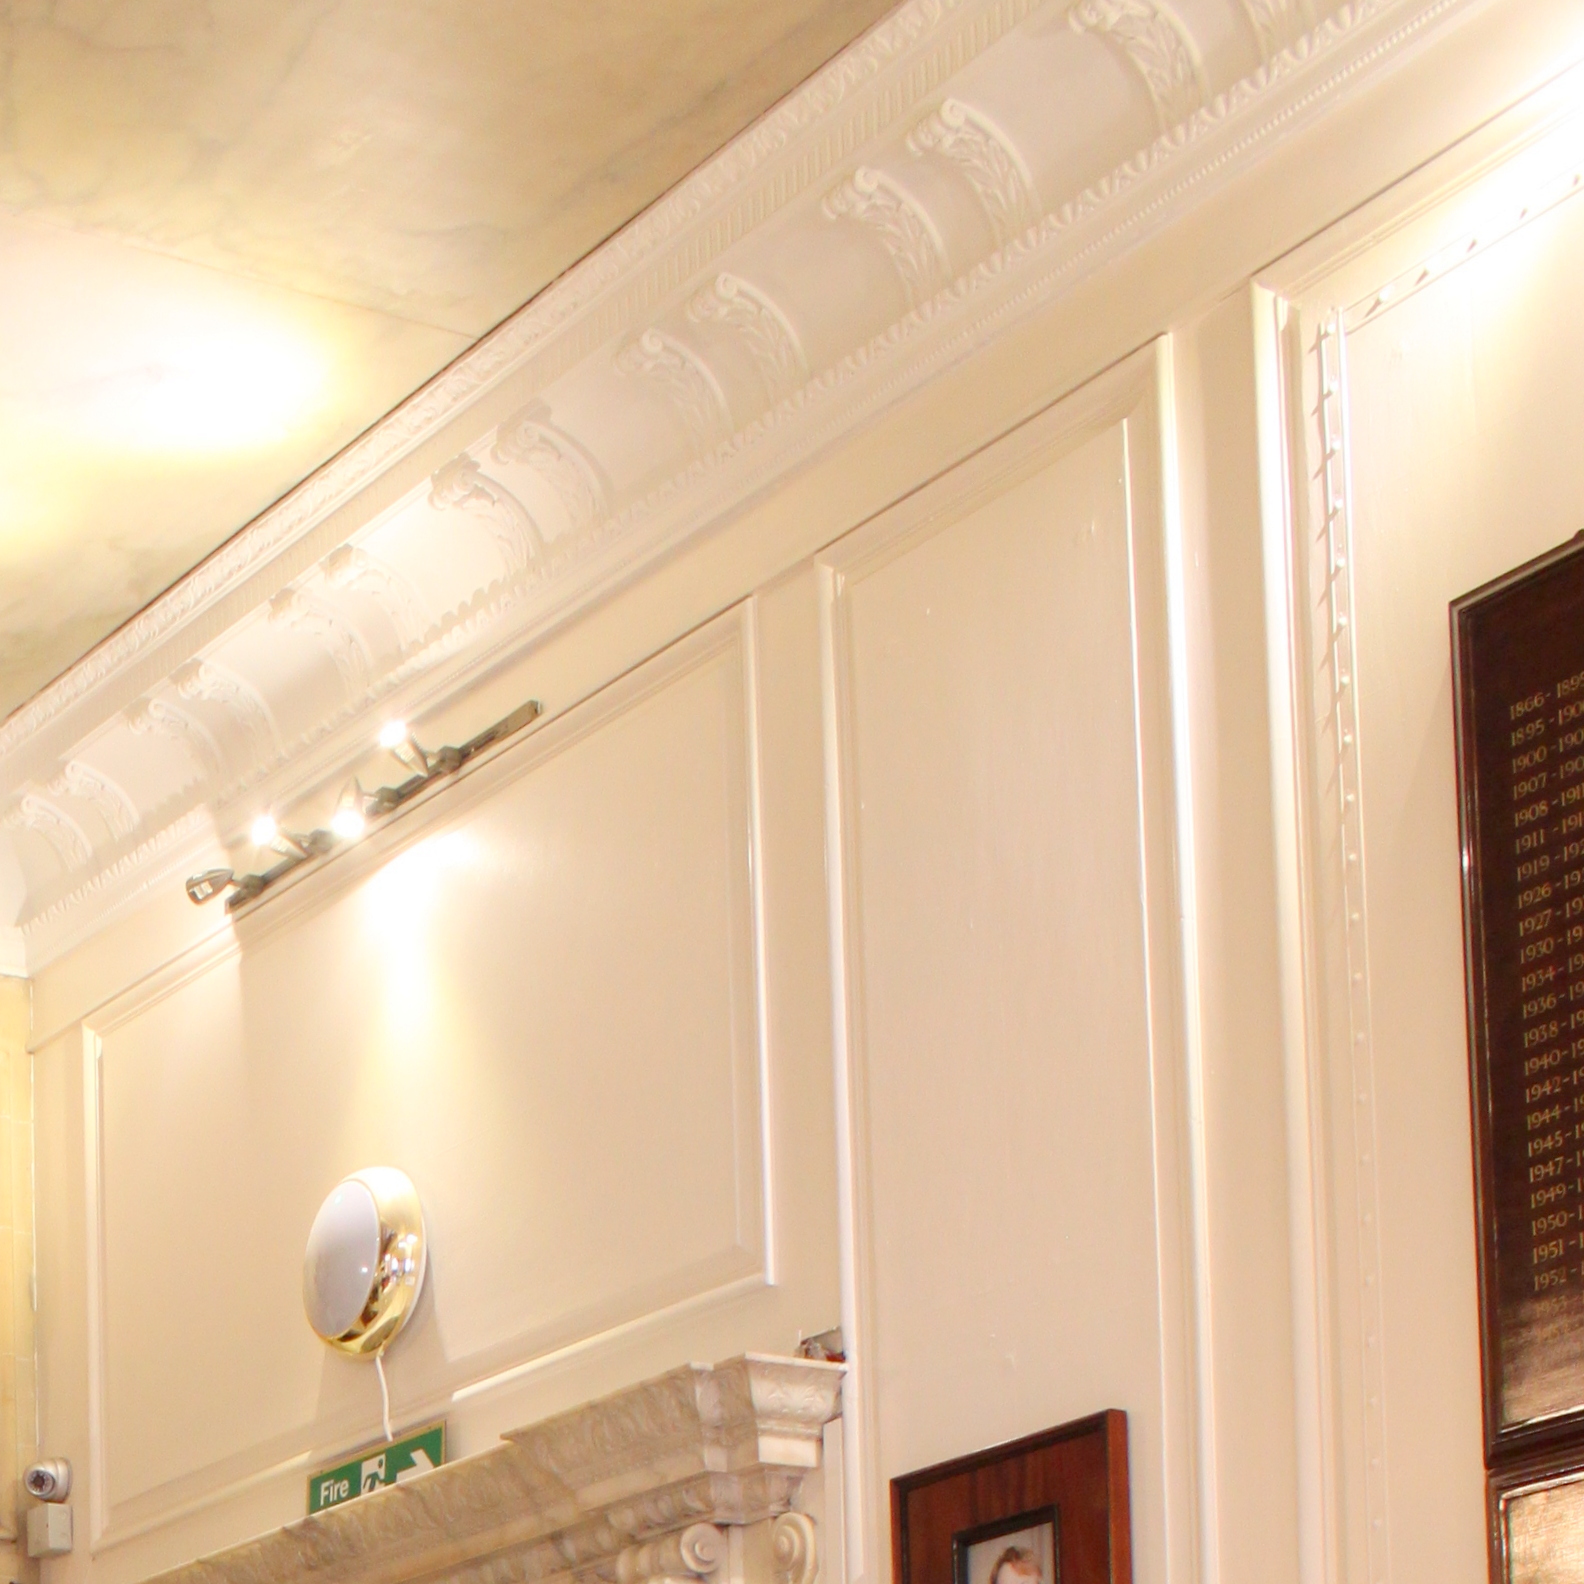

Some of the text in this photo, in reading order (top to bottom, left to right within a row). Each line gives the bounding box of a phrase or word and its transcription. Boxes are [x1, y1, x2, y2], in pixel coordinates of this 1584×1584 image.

[1510, 692, 1545, 720] 1866
[1511, 719, 1545, 747] 1895
[1558, 701, 1584, 725] 190
[1513, 746, 1547, 774] 1900
[1513, 772, 1547, 801] 1907
[1514, 800, 1549, 828] 1908
[1515, 828, 1545, 855] 1911
[1517, 855, 1550, 882] 1919
[1518, 883, 1552, 910] 1926
[1519, 908, 1552, 937] 1927
[1520, 937, 1554, 965] 1930
[1522, 965, 1556, 992] 1934
[1523, 993, 1557, 1020] 1936
[1524, 1020, 1559, 1048] 1938
[1524, 1049, 1561, 1076] 1940
[1526, 1076, 1562, 1104] 1942
[1527, 1104, 1562, 1131] 1944
[1528, 1130, 1563, 1158] 1945
[1529, 1156, 1565, 1184] 1947
[1530, 1183, 1566, 1209] 1949
[1532, 1211, 1568, 1236] 1950
[1533, 1238, 1564, 1264] 1951
[1534, 1265, 1567, 1292] 1952
[320, 1479, 349, 1506] Fire
